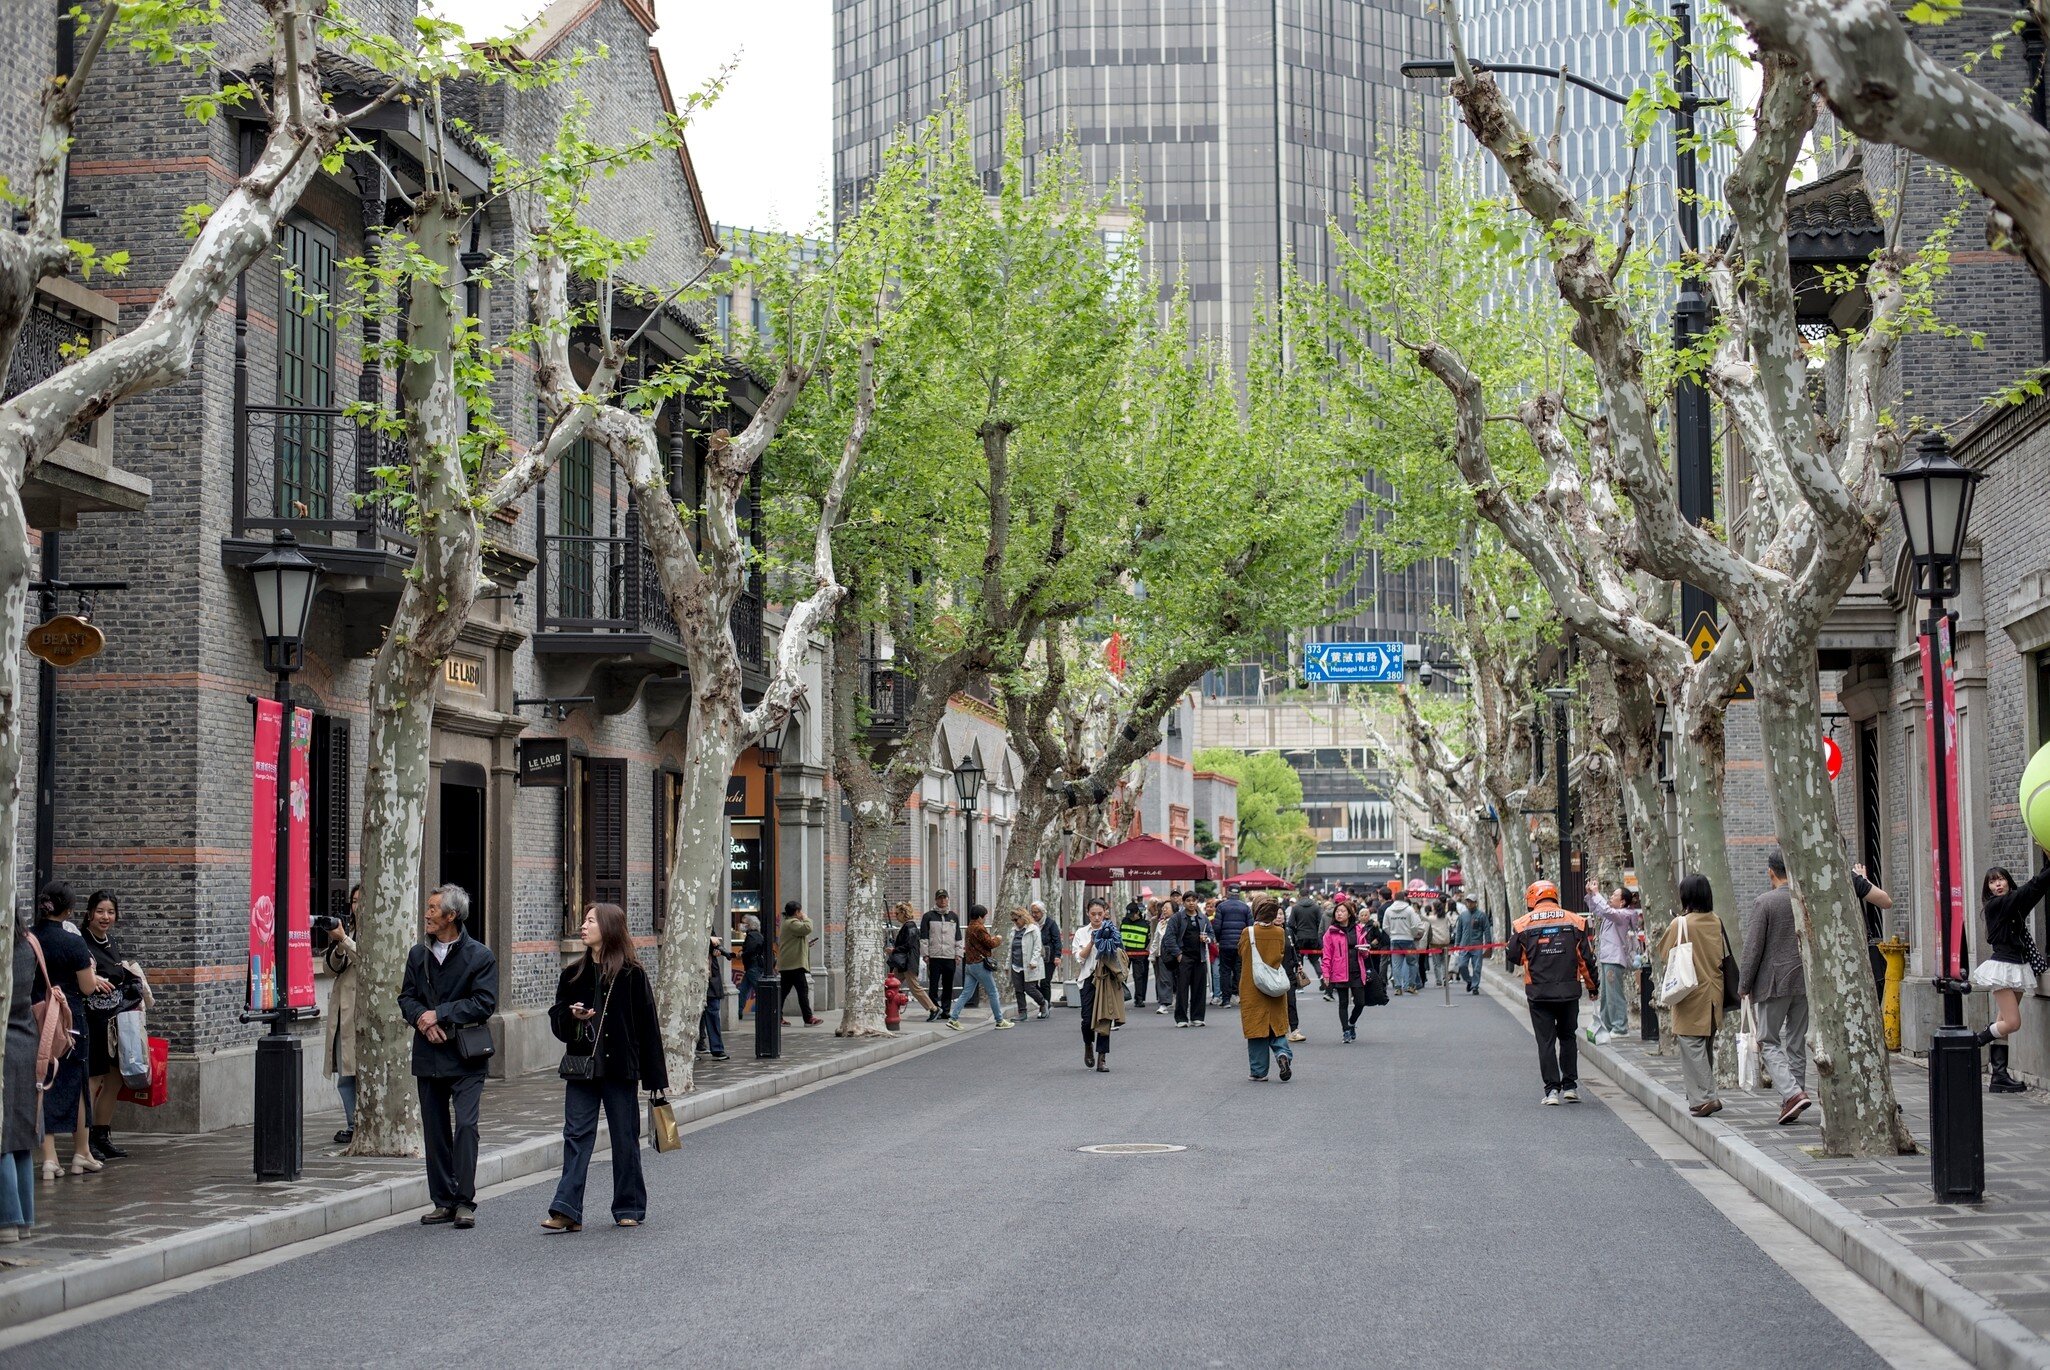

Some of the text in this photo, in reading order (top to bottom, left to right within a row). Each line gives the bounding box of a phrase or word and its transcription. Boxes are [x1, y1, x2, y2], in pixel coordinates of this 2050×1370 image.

[41, 632, 86, 645] BEAST
[1307, 645, 1321, 654] 373
[1386, 644, 1401, 653] 383
[1330, 651, 1377, 663] 黄陂南路
[449, 661, 480, 685] LE LABO
[1307, 672, 1321, 680] 374
[1386, 671, 1401, 680] 380
[528, 759, 540, 768] LE
[540, 754, 561, 765] LABO
